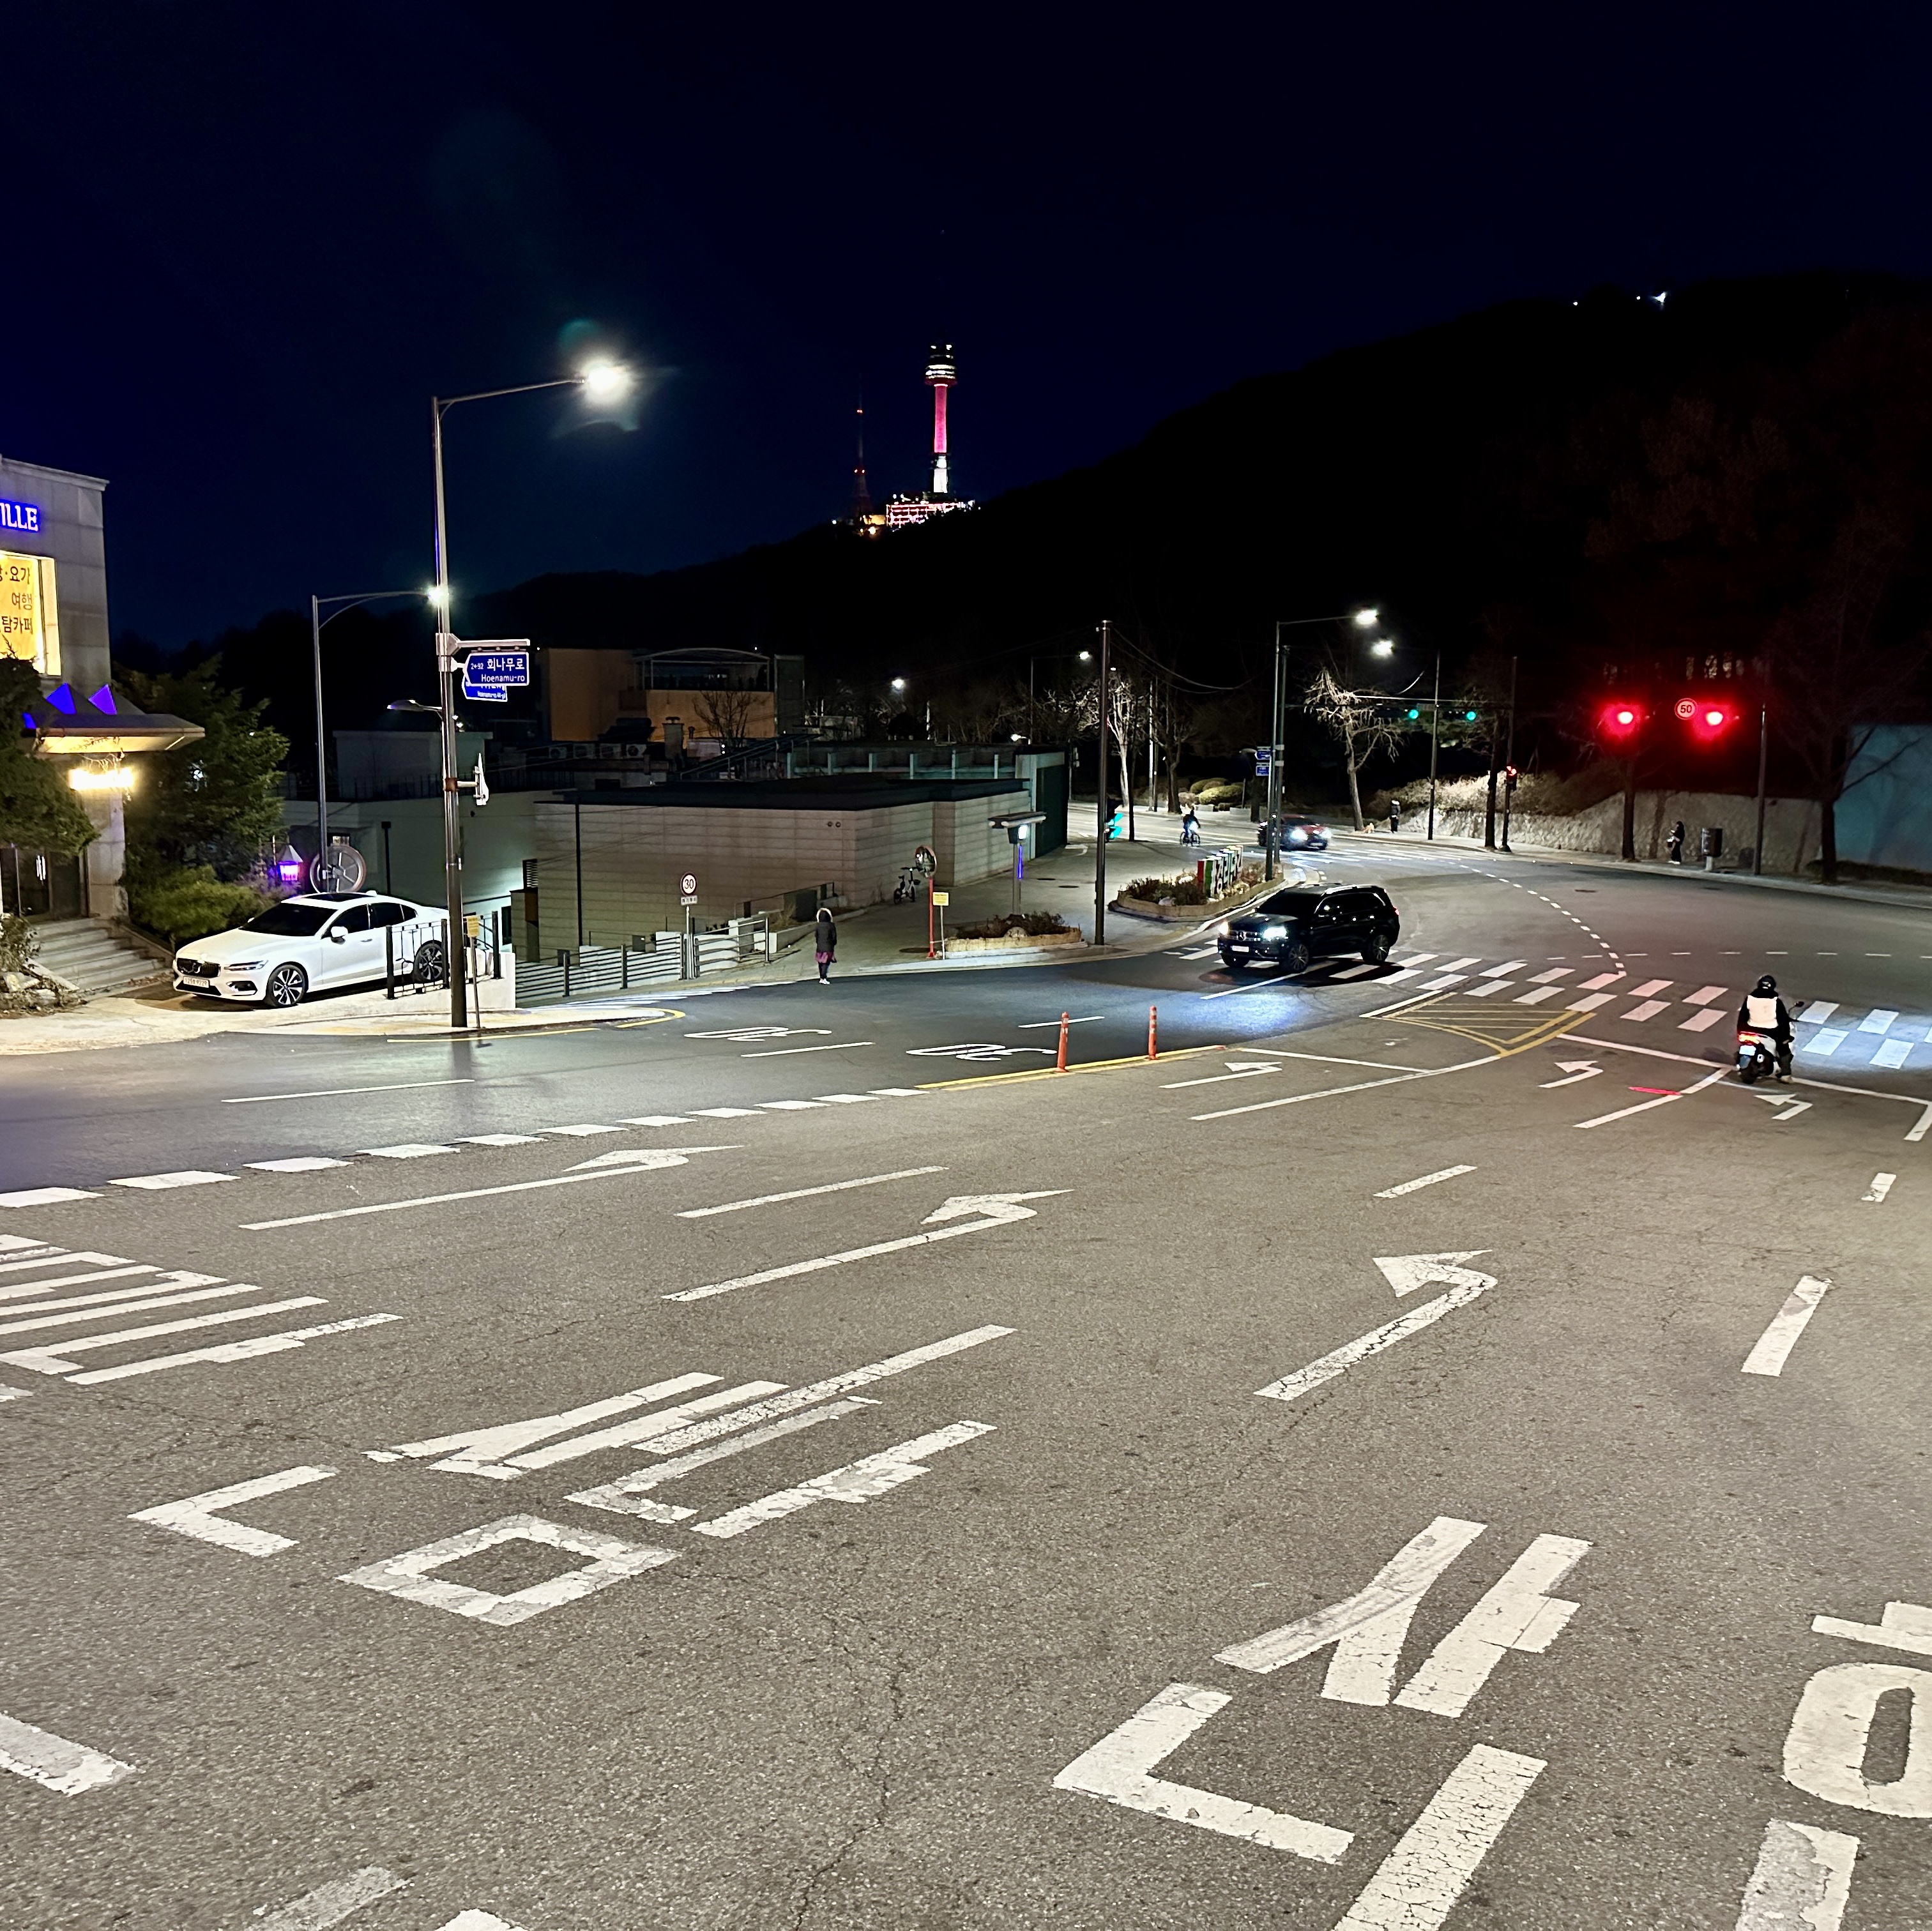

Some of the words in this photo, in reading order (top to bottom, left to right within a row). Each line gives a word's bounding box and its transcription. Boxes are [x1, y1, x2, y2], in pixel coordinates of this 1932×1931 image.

[0, 503, 38, 531] ILLE
[11, 592, 33, 610] 여행
[0, 615, 33, 635] 탐카페
[487, 658, 525, 672] 회나무로
[481, 674, 525, 683] Hoenamu-ro
[1680, 704, 1692, 713] 50
[685, 879, 694, 890] 30
